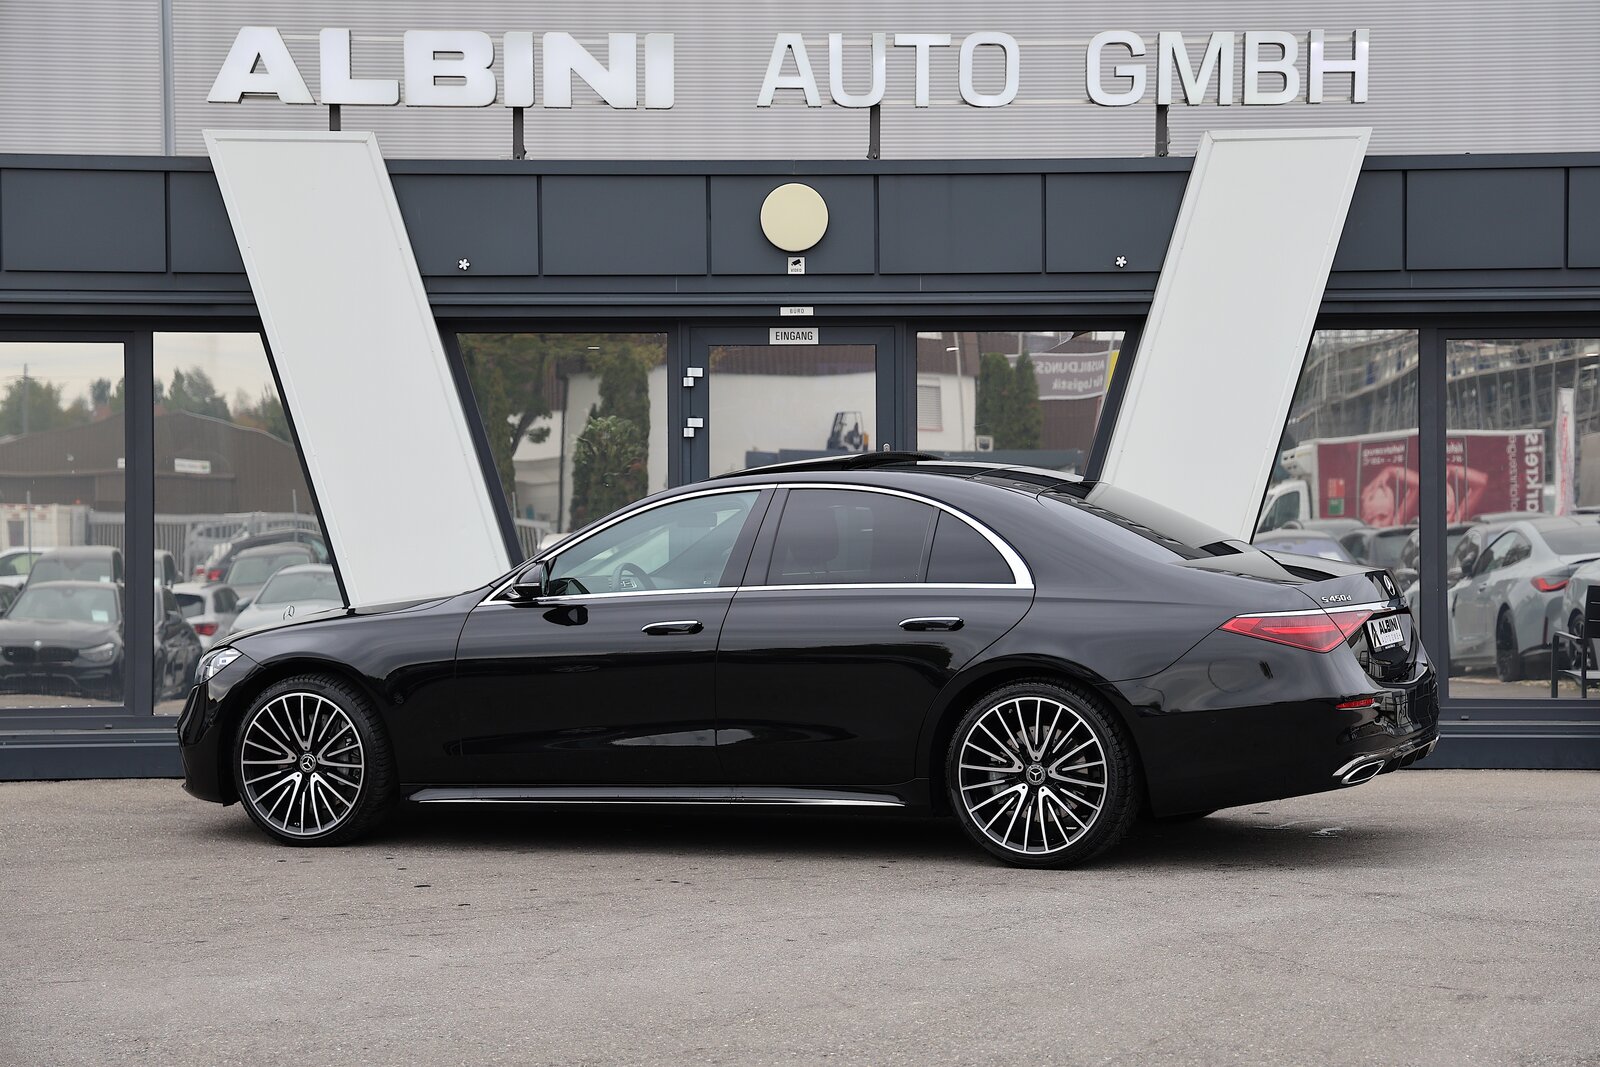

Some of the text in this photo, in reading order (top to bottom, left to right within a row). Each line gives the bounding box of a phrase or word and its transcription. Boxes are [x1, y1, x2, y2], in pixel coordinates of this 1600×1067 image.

[206, 26, 1370, 109] ALBINI AUTO GMBH
[775, 331, 813, 341] EINGANG
[1379, 617, 1399, 635] ALBINI
